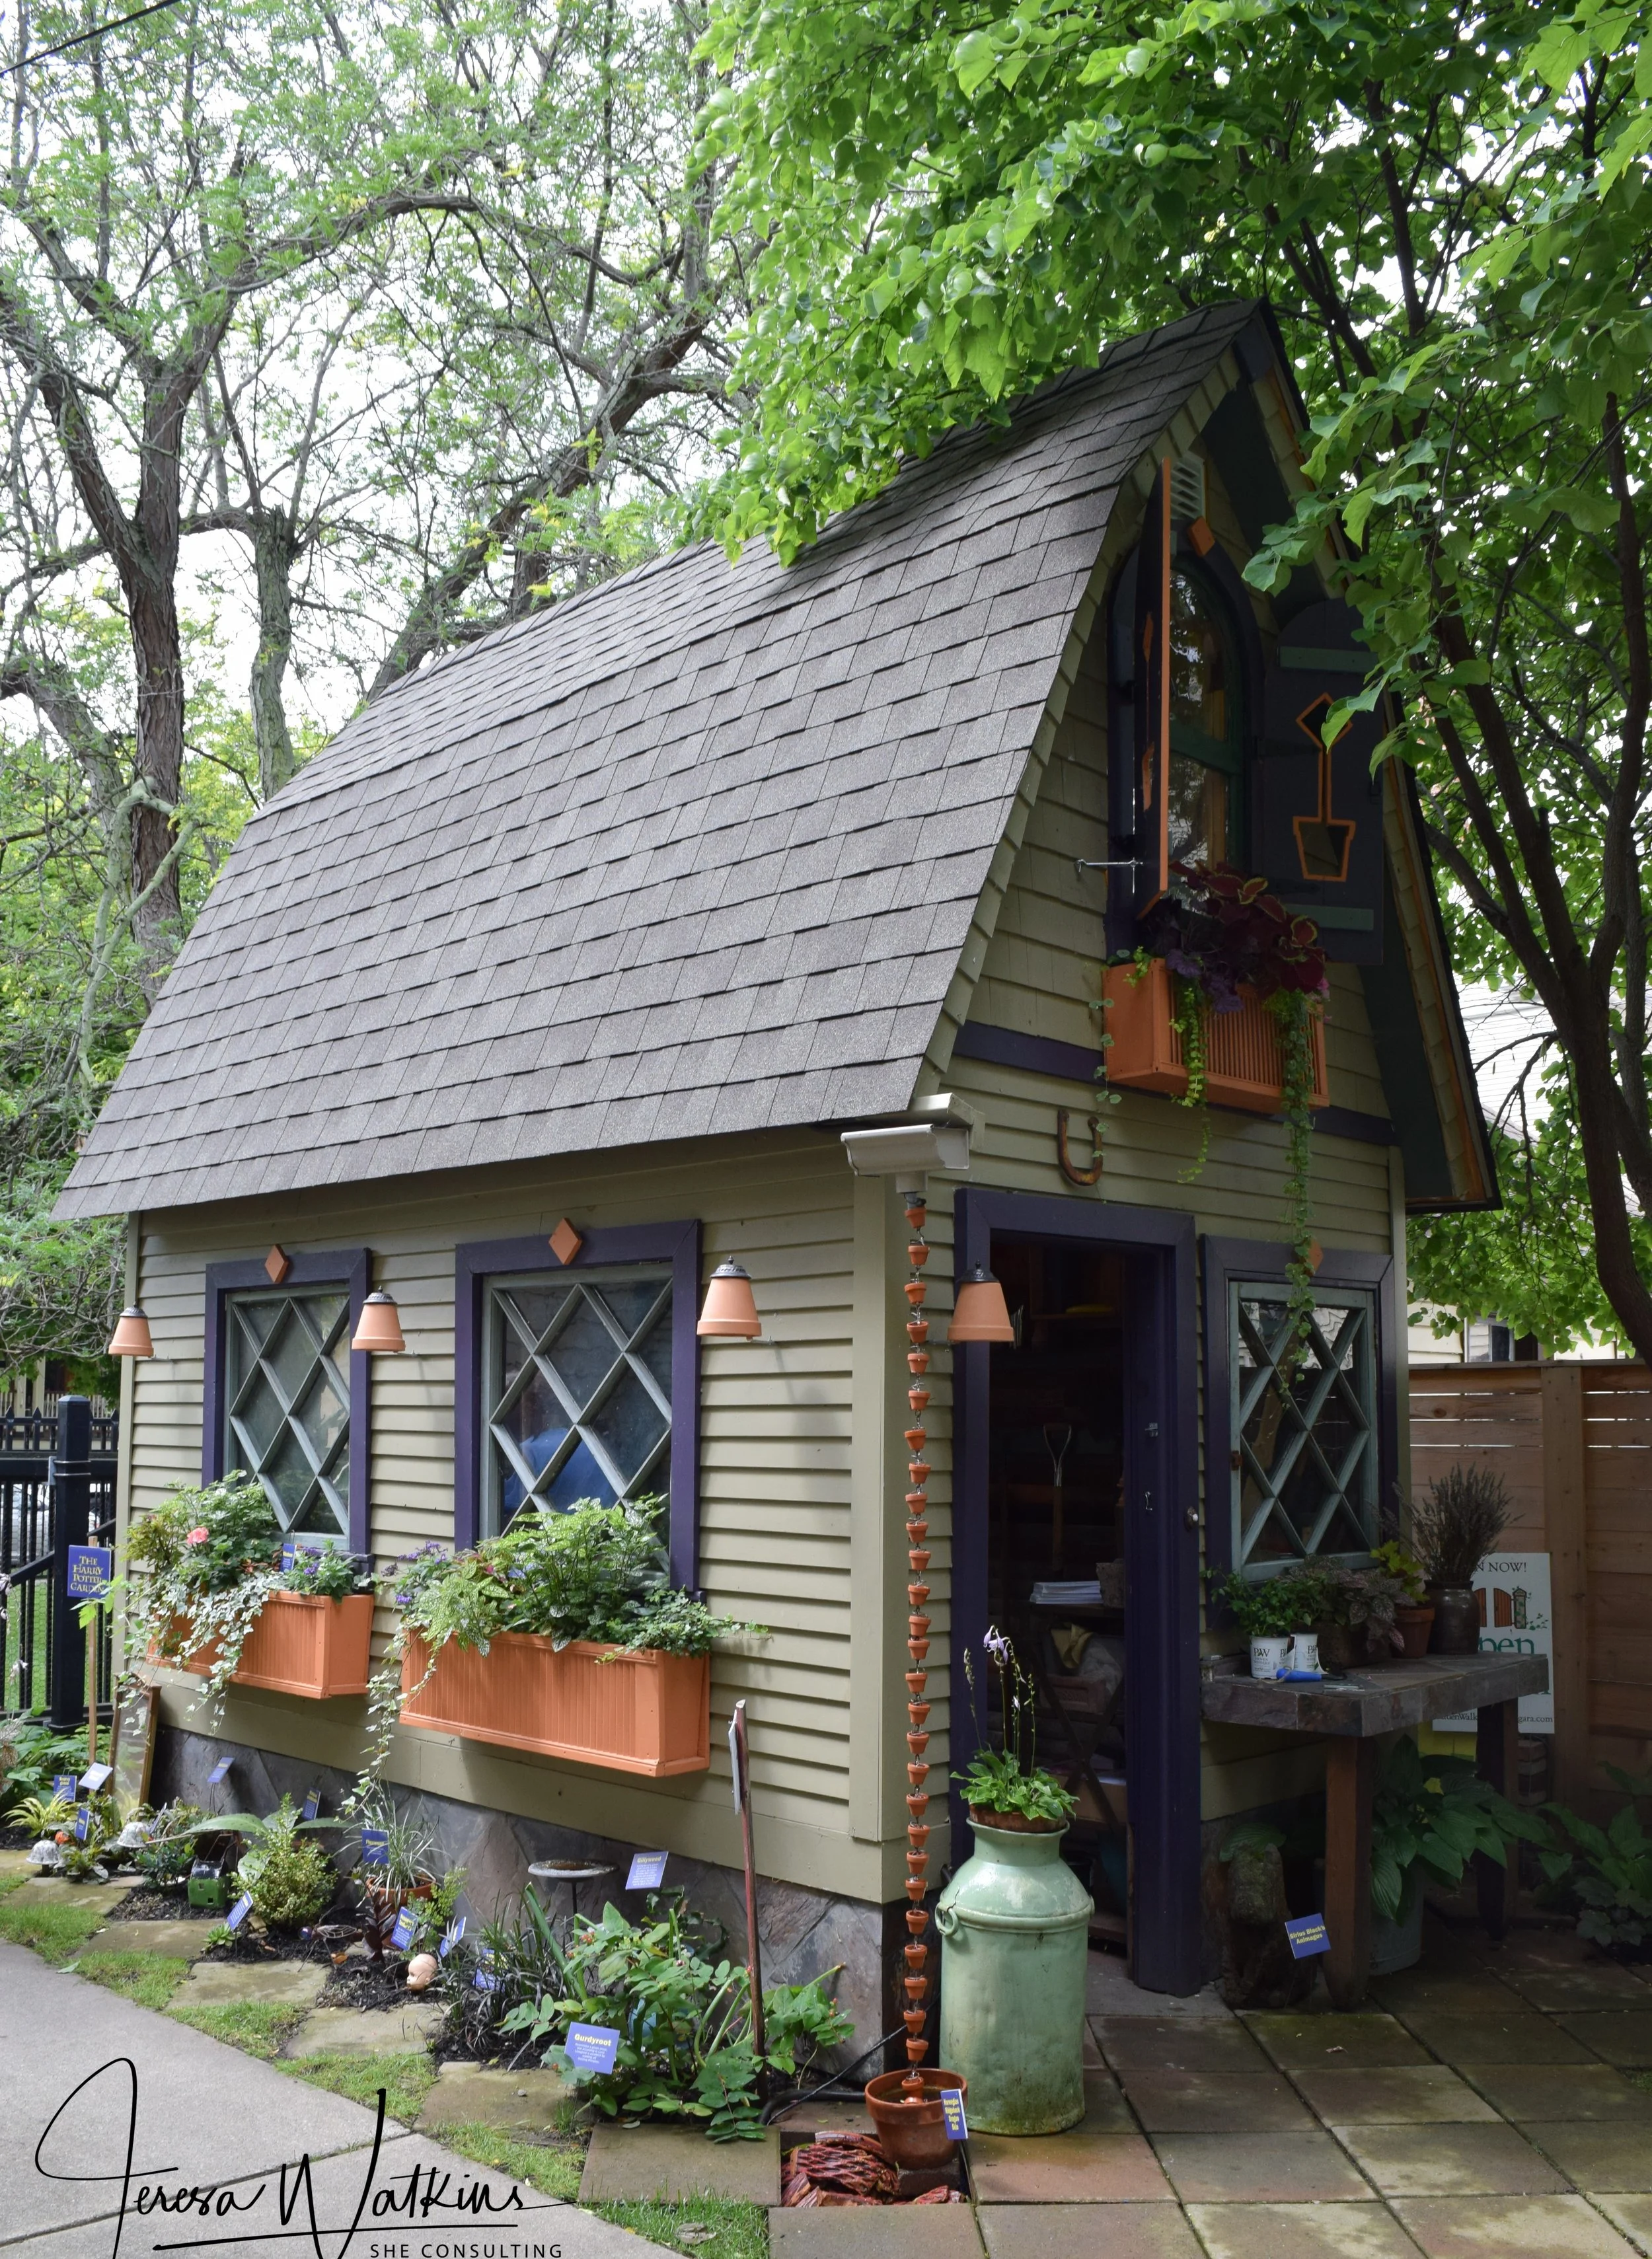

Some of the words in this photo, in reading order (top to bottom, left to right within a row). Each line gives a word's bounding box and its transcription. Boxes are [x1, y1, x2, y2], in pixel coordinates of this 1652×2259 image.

[79, 1555, 98, 1565] THE
[73, 1564, 104, 1575] HARRY
[1488, 1562, 1527, 1573] NOW!
[73, 1573, 102, 1584] POTTER
[1479, 1636, 1535, 1654] pen
[1289, 1930, 1306, 1939] Sirius
[1306, 1925, 1326, 1935] Black's
[574, 2033, 612, 2047] Gurdyroot
